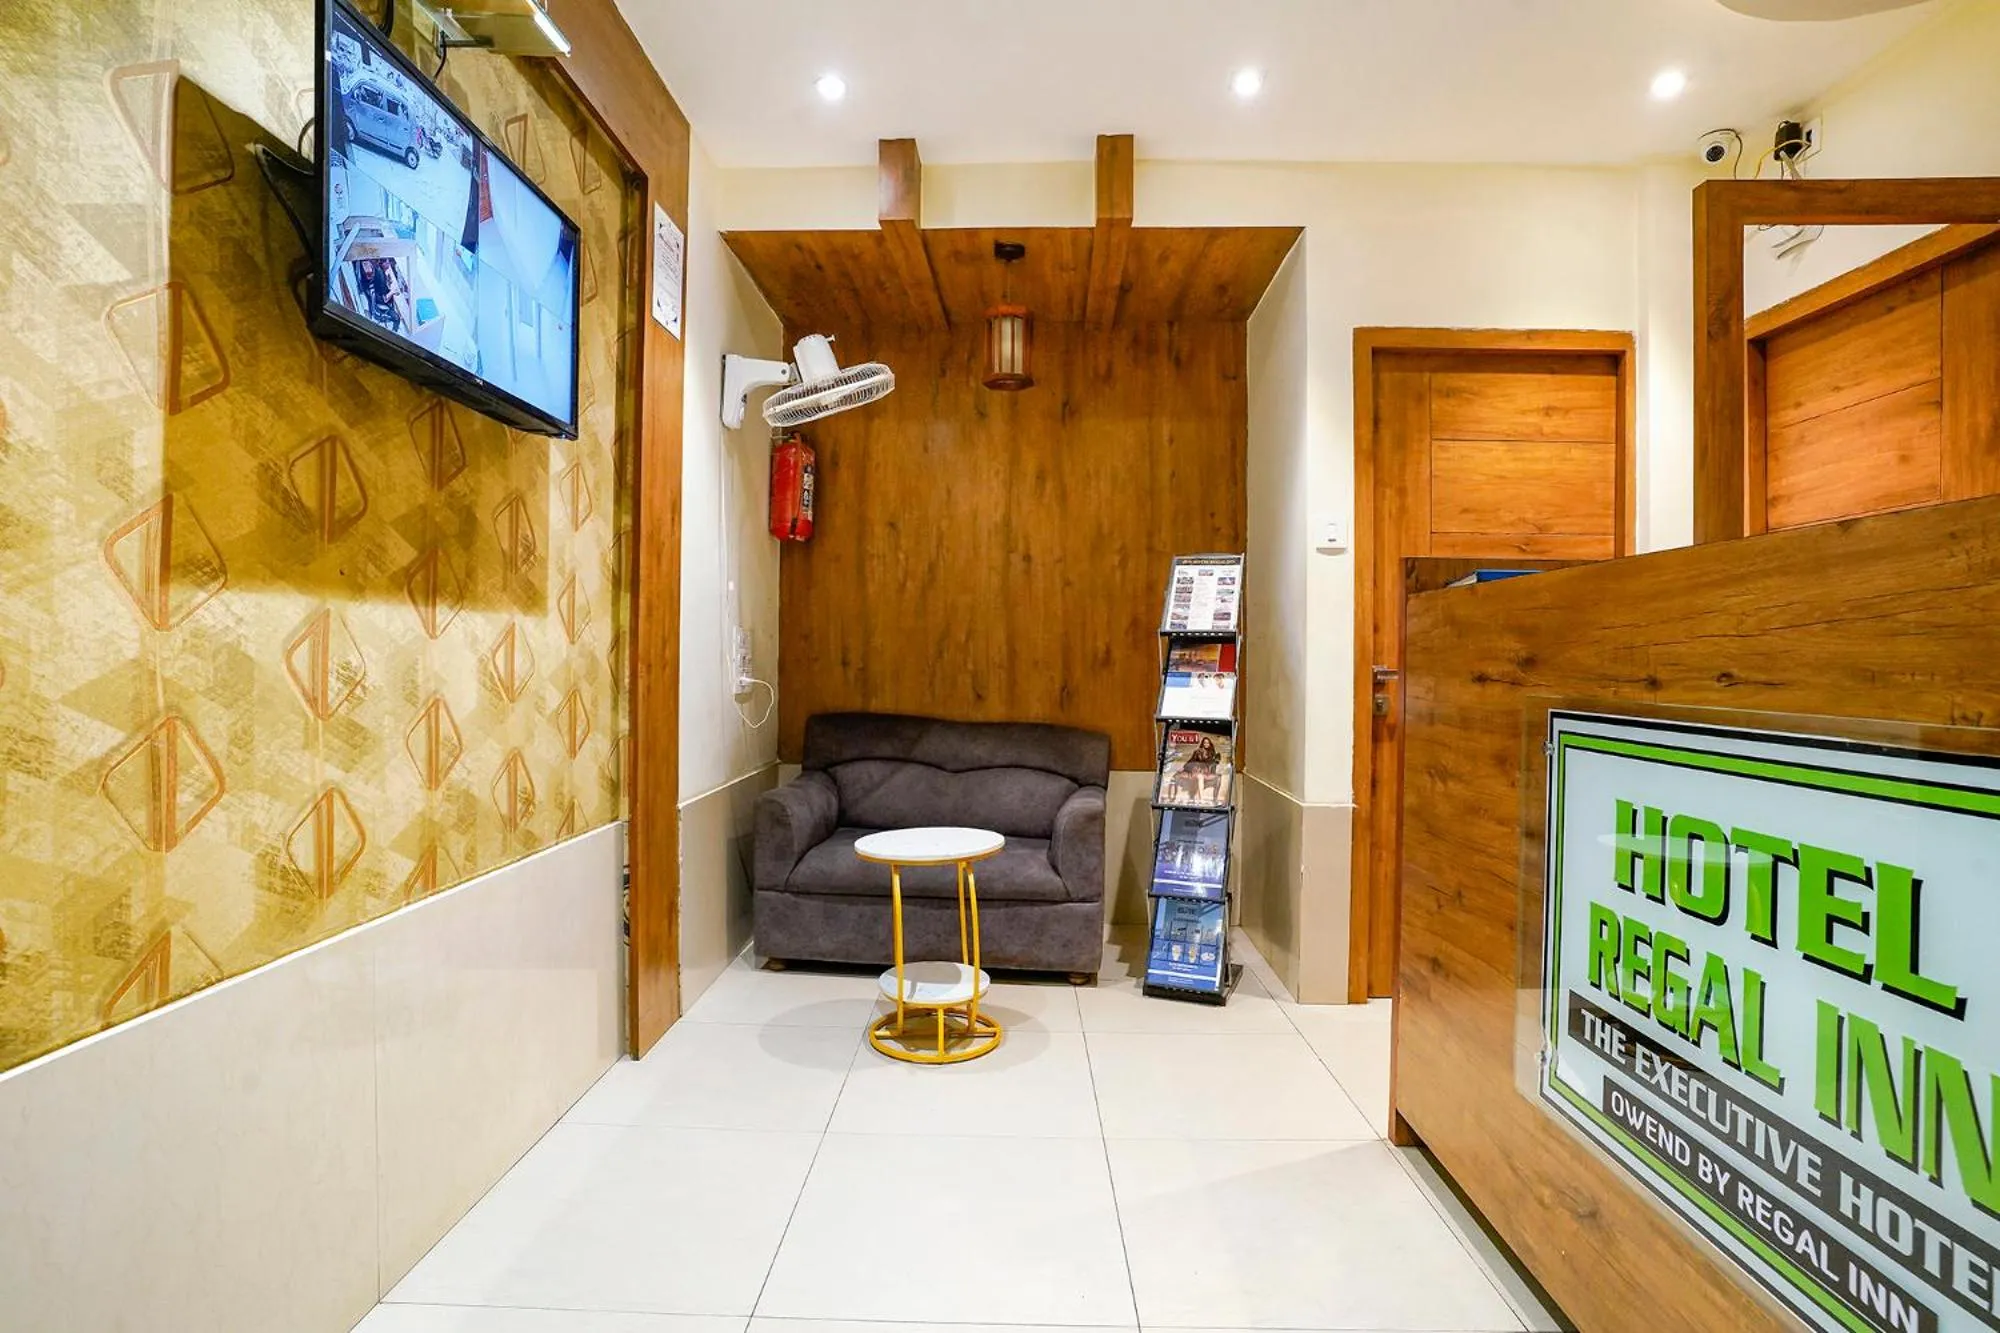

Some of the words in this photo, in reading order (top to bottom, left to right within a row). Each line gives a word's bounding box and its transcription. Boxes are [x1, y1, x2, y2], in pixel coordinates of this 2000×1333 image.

[1613, 798, 1968, 1022] HOTEL
[1581, 1008, 1626, 1065] THE
[1635, 1042, 1822, 1198] EXECUTIVE
[1840, 1170, 2000, 1321] HOTE
[1587, 901, 1786, 1096] REGAL
[1814, 998, 2000, 1223] INN
[1611, 1090, 1690, 1168] OWEND
[1697, 1152, 1731, 1197] BY
[1737, 1181, 1839, 1283] REGAL
[1848, 1260, 1919, 1333] INN
